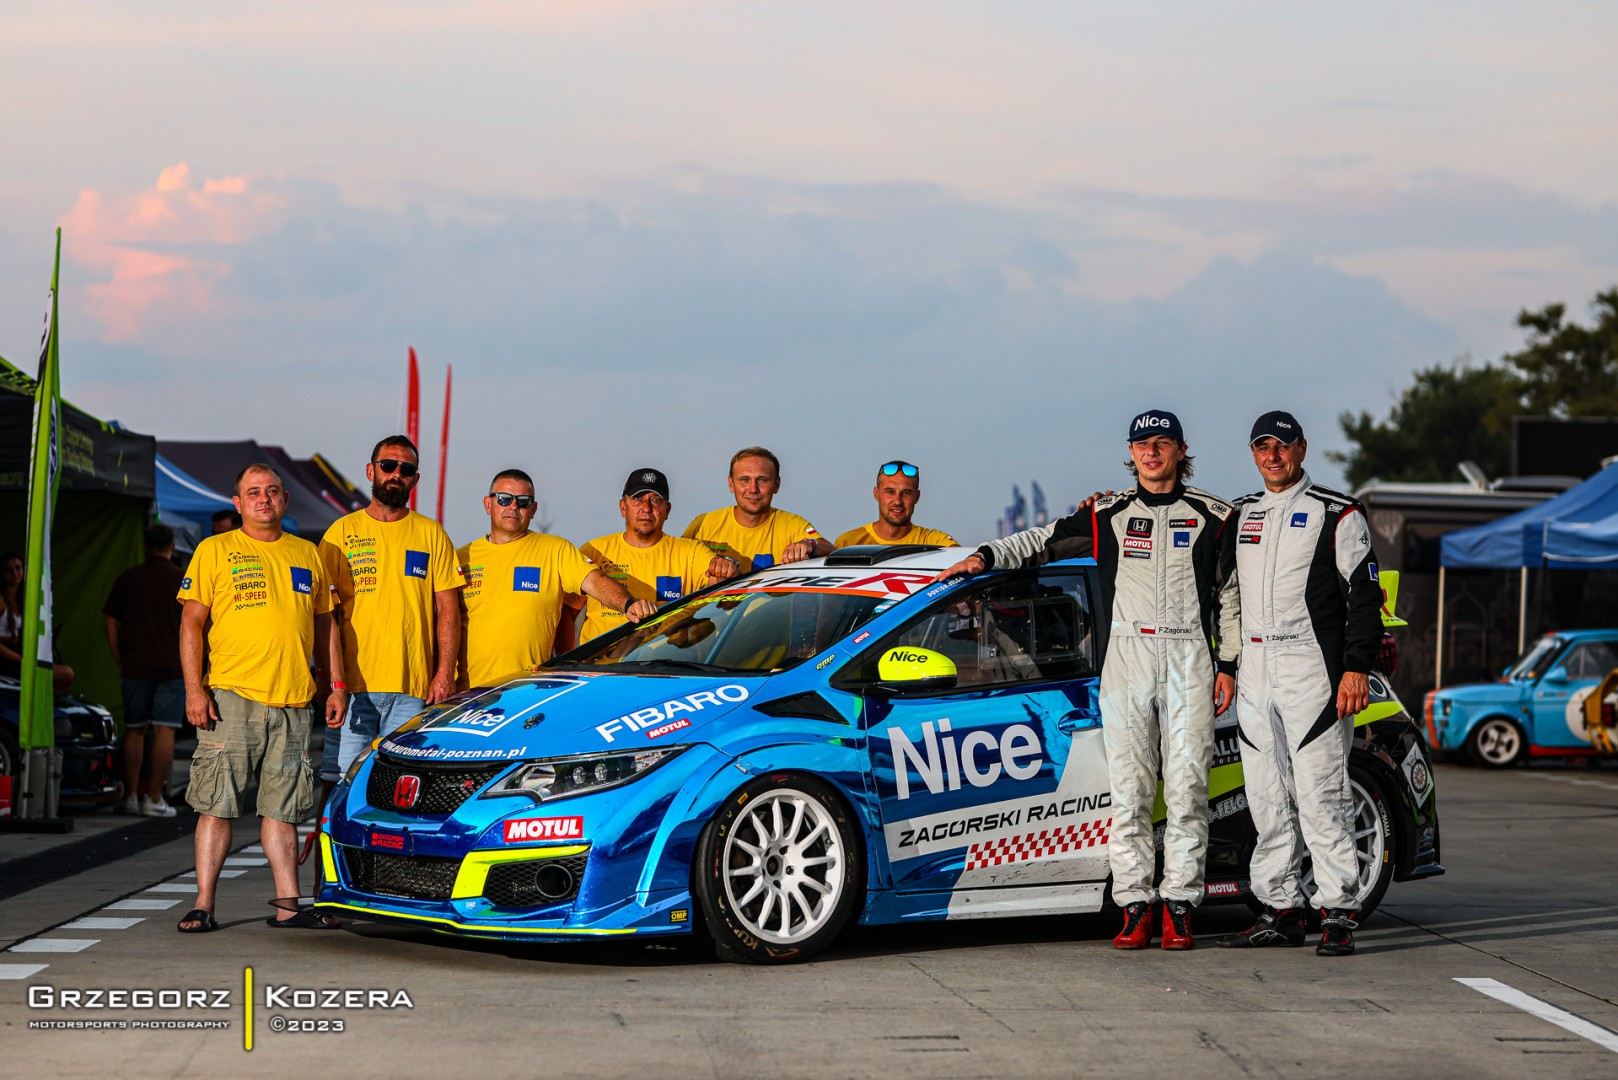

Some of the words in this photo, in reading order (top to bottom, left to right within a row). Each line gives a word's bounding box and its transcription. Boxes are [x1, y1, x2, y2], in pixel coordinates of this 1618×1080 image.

[1134, 415, 1171, 431] Nice
[1276, 421, 1292, 429] Nice
[1211, 503, 1228, 514] OMP
[1124, 540, 1152, 549] MOTUL
[412, 566, 427, 576] Nice
[234, 581, 267, 591] FIBARO
[521, 581, 539, 589] Nice
[234, 591, 267, 602] HI-SPEED
[664, 590, 681, 598] Nice
[889, 651, 928, 663] Nice
[449, 709, 506, 727] Nice
[595, 684, 750, 743] FIBARO
[648, 720, 690, 739] MOTUL
[887, 717, 1043, 800] Nice
[1377, 800, 1391, 837] YOKOHAMA
[507, 818, 581, 840] MOTUL
[377, 840, 404, 850] RACING
[1208, 883, 1238, 894] MOTUL
[671, 912, 687, 920] OMP
